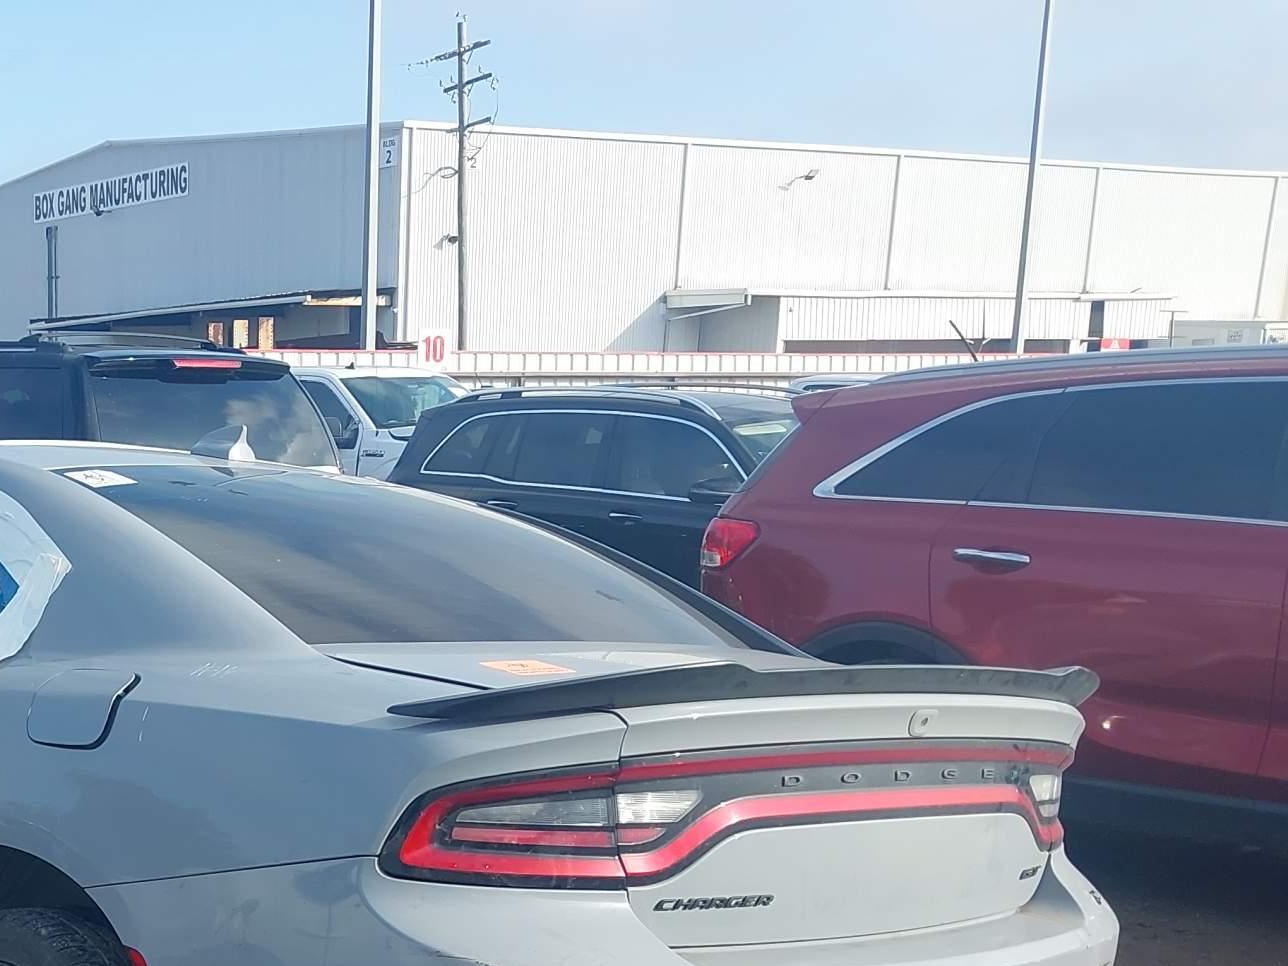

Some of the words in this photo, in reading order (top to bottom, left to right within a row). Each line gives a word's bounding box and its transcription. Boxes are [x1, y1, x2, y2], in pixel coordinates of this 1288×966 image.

[385, 149, 392, 164] 2
[34, 191, 55, 221] BOX
[57, 186, 86, 214] GANG
[89, 165, 187, 211] MANUFACTURING
[422, 335, 444, 362] 10
[781, 767, 995, 787] DODGE
[653, 894, 774, 911] CHARGER
